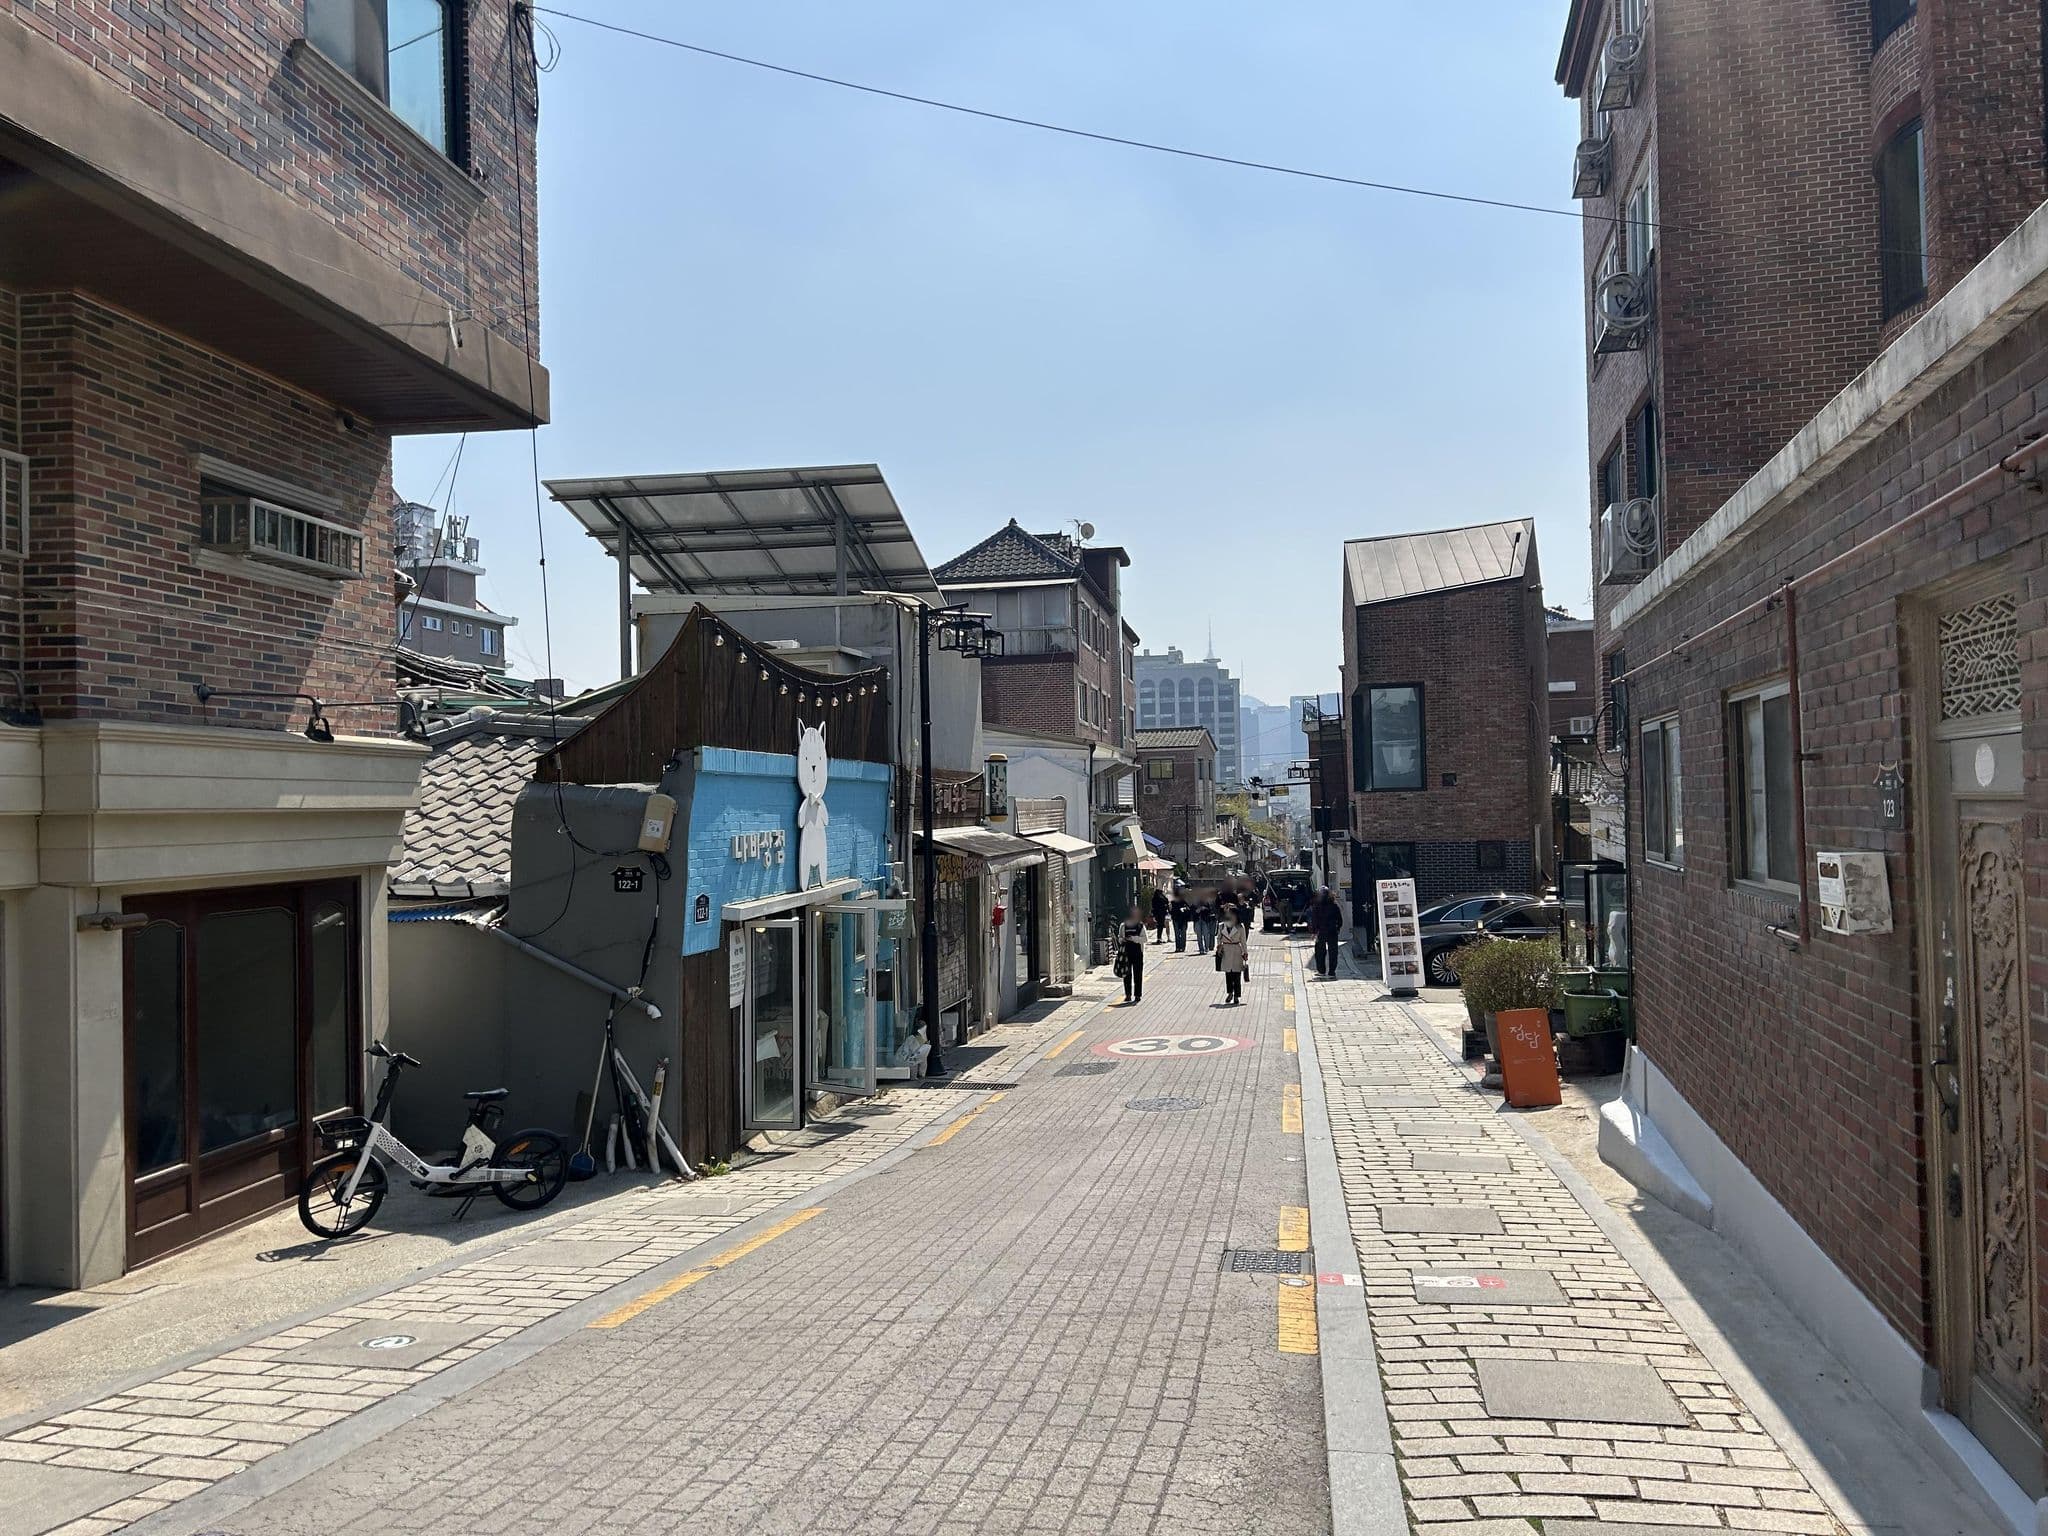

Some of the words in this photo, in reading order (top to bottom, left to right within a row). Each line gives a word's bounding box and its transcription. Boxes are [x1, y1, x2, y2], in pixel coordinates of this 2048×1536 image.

[1883, 799, 1895, 818] 123
[618, 880, 639, 889] 122-1
[697, 907, 709, 920] 122-1
[1119, 1037, 1224, 1053] 30
